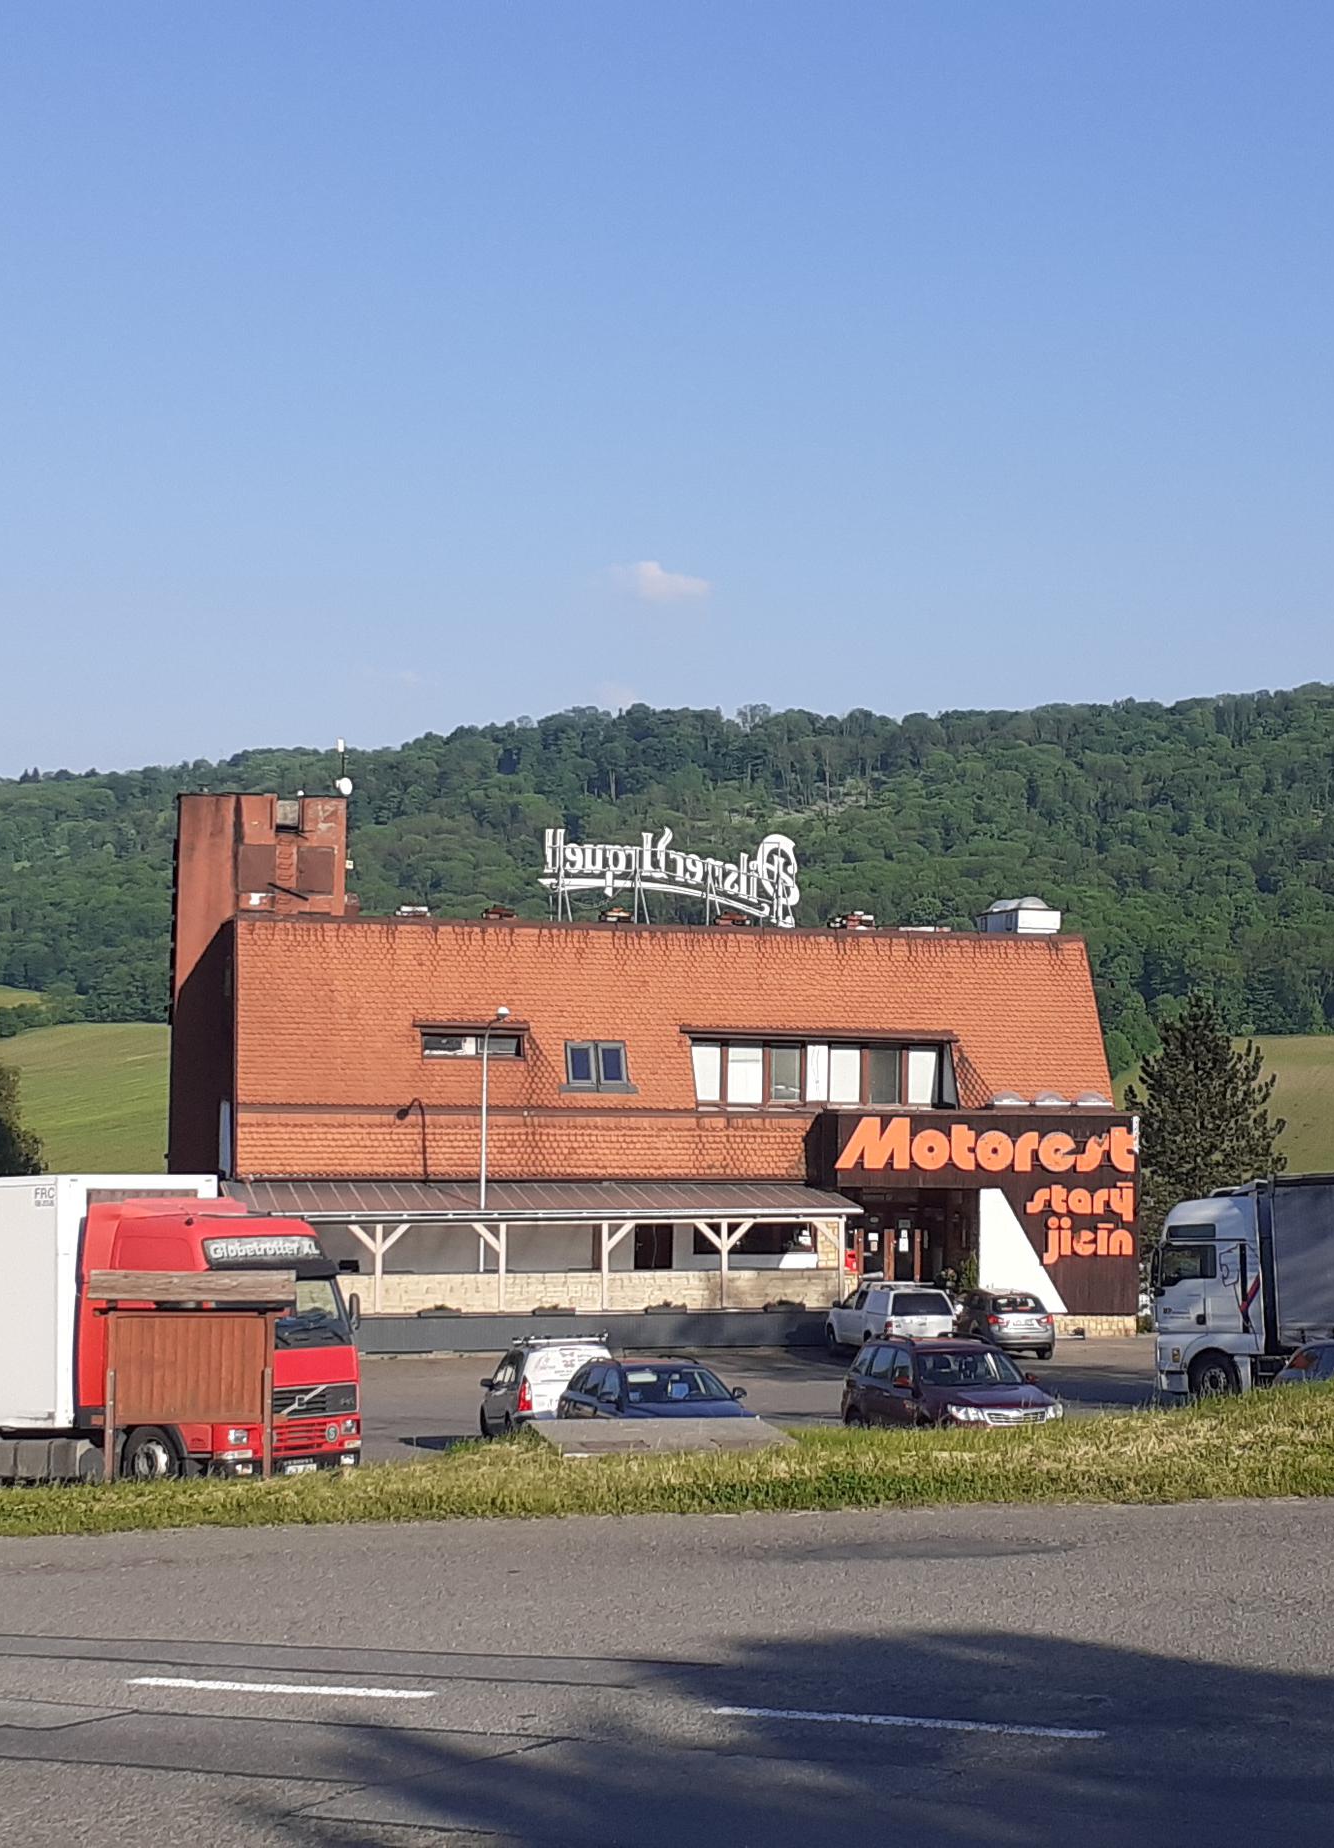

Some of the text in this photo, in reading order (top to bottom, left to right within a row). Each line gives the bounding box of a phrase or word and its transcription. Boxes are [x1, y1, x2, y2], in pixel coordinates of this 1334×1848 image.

[835, 1116, 1135, 1172] Motorest
[209, 1240, 320, 1258] Globetrotter XL
